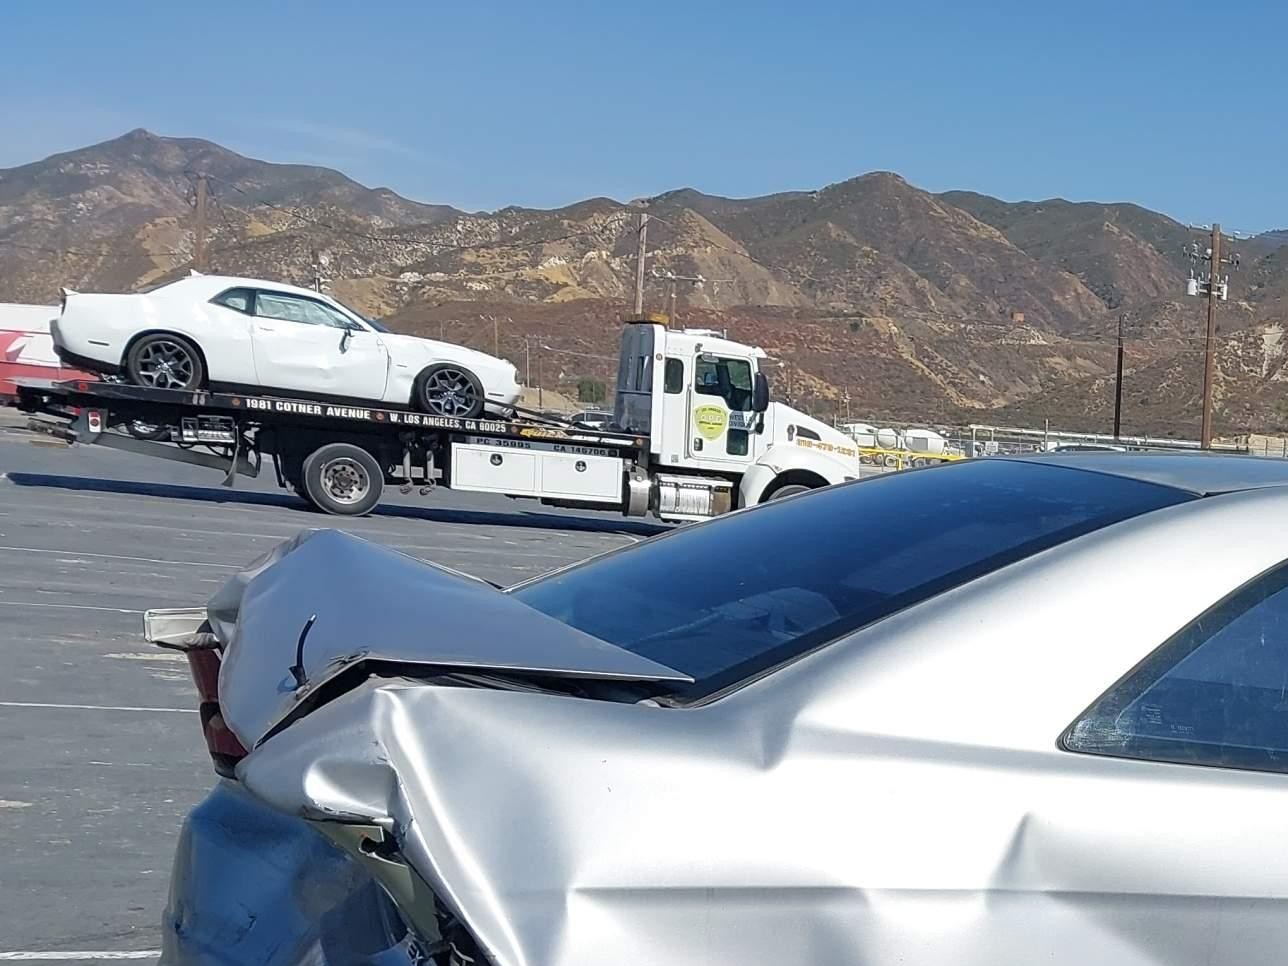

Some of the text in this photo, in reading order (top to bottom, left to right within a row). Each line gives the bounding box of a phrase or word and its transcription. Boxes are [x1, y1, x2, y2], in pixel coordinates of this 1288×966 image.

[246, 398, 371, 419] 1981 COTNER AVENUE
[390, 413, 401, 422] W.
[404, 414, 420, 424] LOS
[422, 417, 462, 429] ANGELES,
[465, 421, 476, 430] CA
